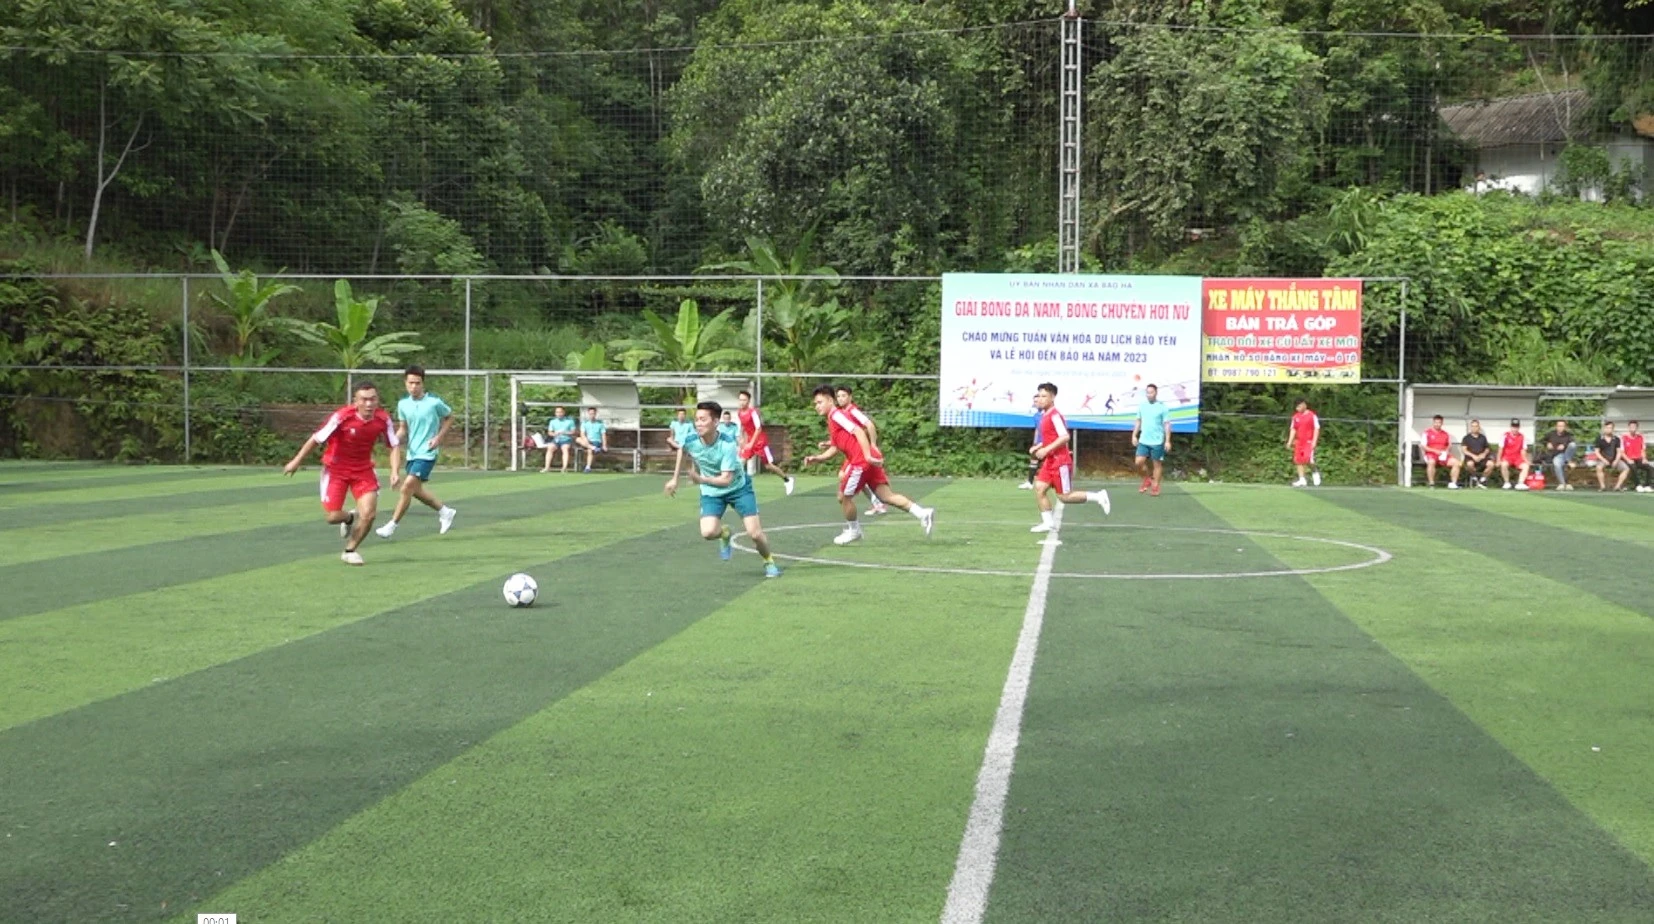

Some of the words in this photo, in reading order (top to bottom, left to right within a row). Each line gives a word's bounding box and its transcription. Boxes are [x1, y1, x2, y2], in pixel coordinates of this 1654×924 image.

[1208, 289, 1228, 311] XE
[1230, 285, 1265, 311] MÁY
[1267, 281, 1320, 311] THẮNG
[1321, 285, 1358, 311] TÂM
[1225, 313, 1260, 331] BÁN
[1265, 313, 1299, 331] TRẢ
[1303, 313, 1337, 331] GÓP
[1094, 333, 1108, 345] DU
[1260, 337, 1272, 347] XE
[1319, 337, 1331, 347] XE
[1123, 351, 1148, 363] 2023
